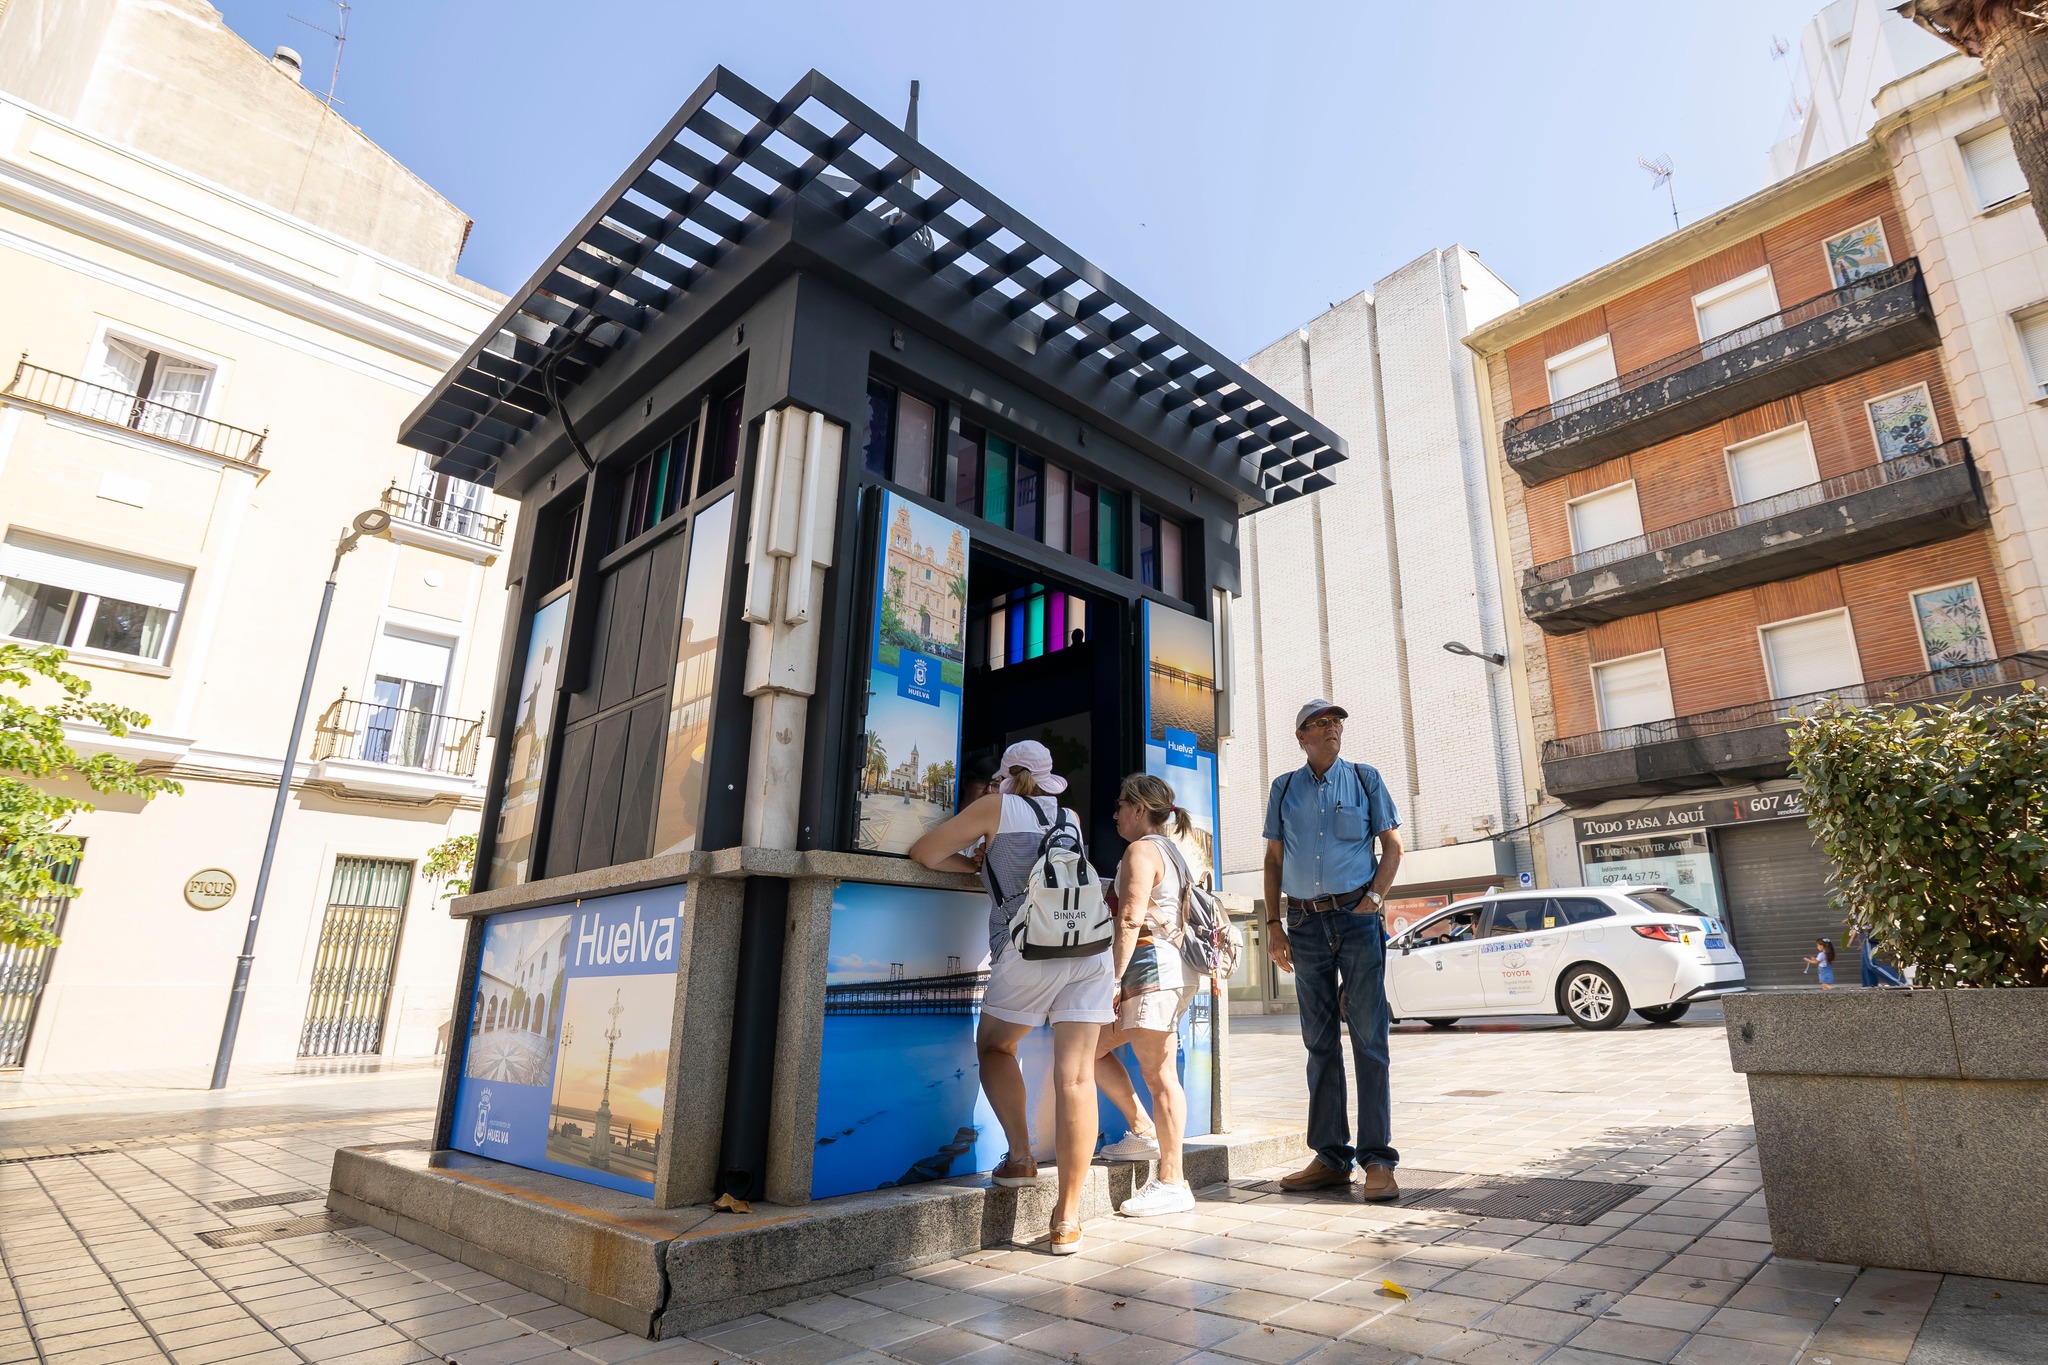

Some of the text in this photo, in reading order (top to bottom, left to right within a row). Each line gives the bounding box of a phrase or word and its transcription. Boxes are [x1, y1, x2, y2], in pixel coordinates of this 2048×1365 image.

[908, 688, 930, 699] HUELVA
[1168, 740, 1193, 754] Huelva
[1751, 796, 1779, 811] 607
[1583, 805, 1706, 835] TODO PASA AQUÍ
[1595, 847, 1636, 857] IMAGINA
[1639, 843, 1665, 853] VIVIR
[1602, 871, 1661, 884] 607 44 57 75
[189, 881, 232, 894] FICUS
[1053, 911, 1087, 920] BINNAR
[575, 905, 676, 966] Huelva
[1502, 970, 1531, 978] TOYOTA
[487, 1129, 509, 1144] HUELVA
